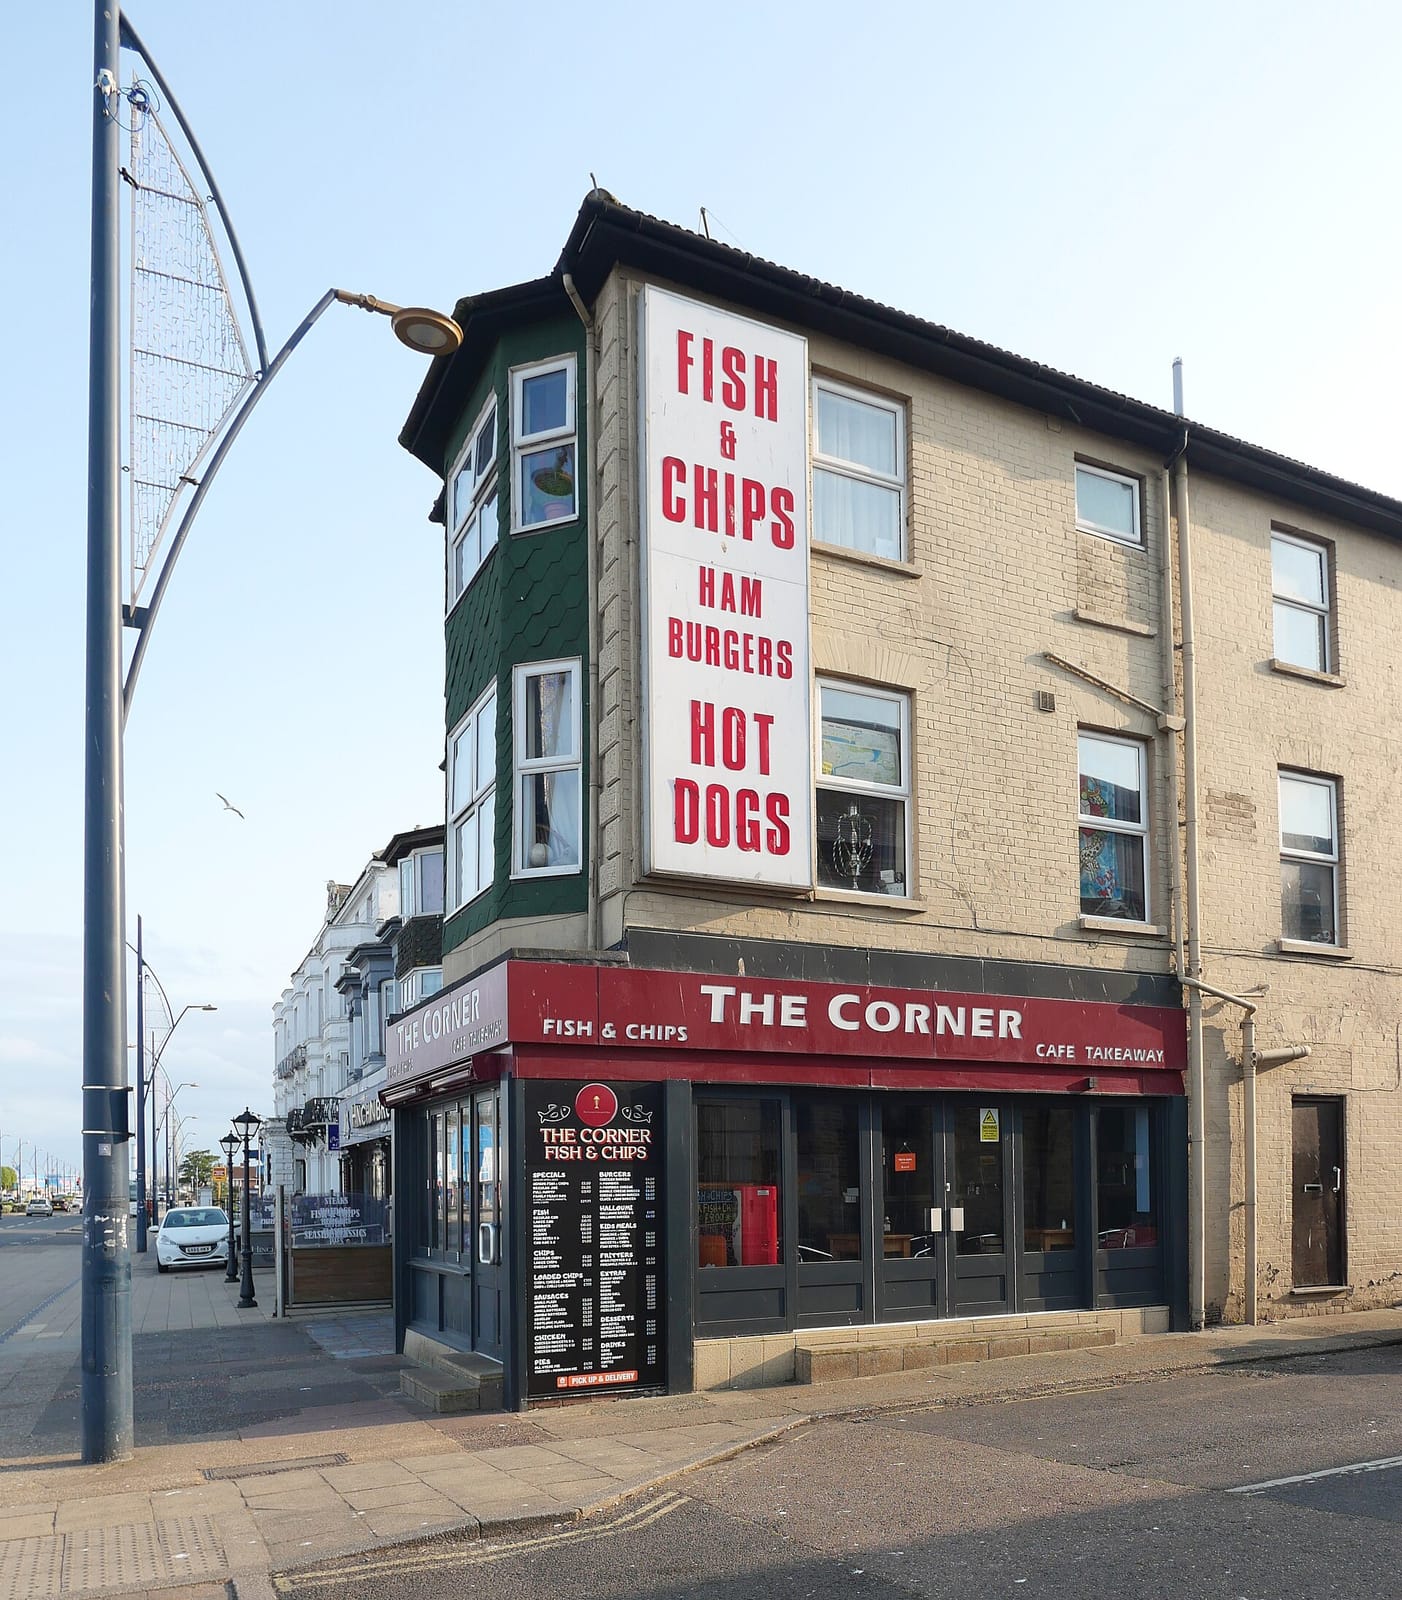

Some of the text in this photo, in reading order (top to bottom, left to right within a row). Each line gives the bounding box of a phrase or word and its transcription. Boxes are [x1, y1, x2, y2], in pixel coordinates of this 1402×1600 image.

[677, 329, 778, 423] FISH
[720, 420, 737, 461] &
[662, 455, 795, 550] CHIPS
[699, 565, 762, 618] HAM
[668, 617, 793, 680] BURGERS
[690, 699, 774, 776] HOT
[674, 777, 790, 856] DOGS
[700, 984, 1023, 1039] THE CORNER
[396, 989, 480, 1057] THE CORNER
[543, 1018, 688, 1042] FISH & CHIPS
[468, 1018, 502, 1047] TAKEAWAY
[1036, 1043, 1165, 1063] CAFE TAKEAWAY
[540, 1127, 653, 1144] THE CORNER
[544, 1145, 648, 1161] FISH & CHIPS
[324, 1197, 349, 1205] STEAKS
[711, 1190, 733, 1201] CHIPS
[599, 1204, 633, 1212] HALLOUMI
[533, 1249, 555, 1257] CHIPS
[599, 1251, 634, 1259] FRITTERS
[533, 1273, 562, 1281] LOADED
[533, 1293, 569, 1301] SAUSAGES
[600, 1315, 635, 1323] DESSERTS
[534, 1333, 566, 1341] CHICKEN
[600, 1341, 626, 1349] DRINKS
[534, 1358, 551, 1366] PIES
[572, 1372, 635, 1385] PICK UP & DELIVERY
